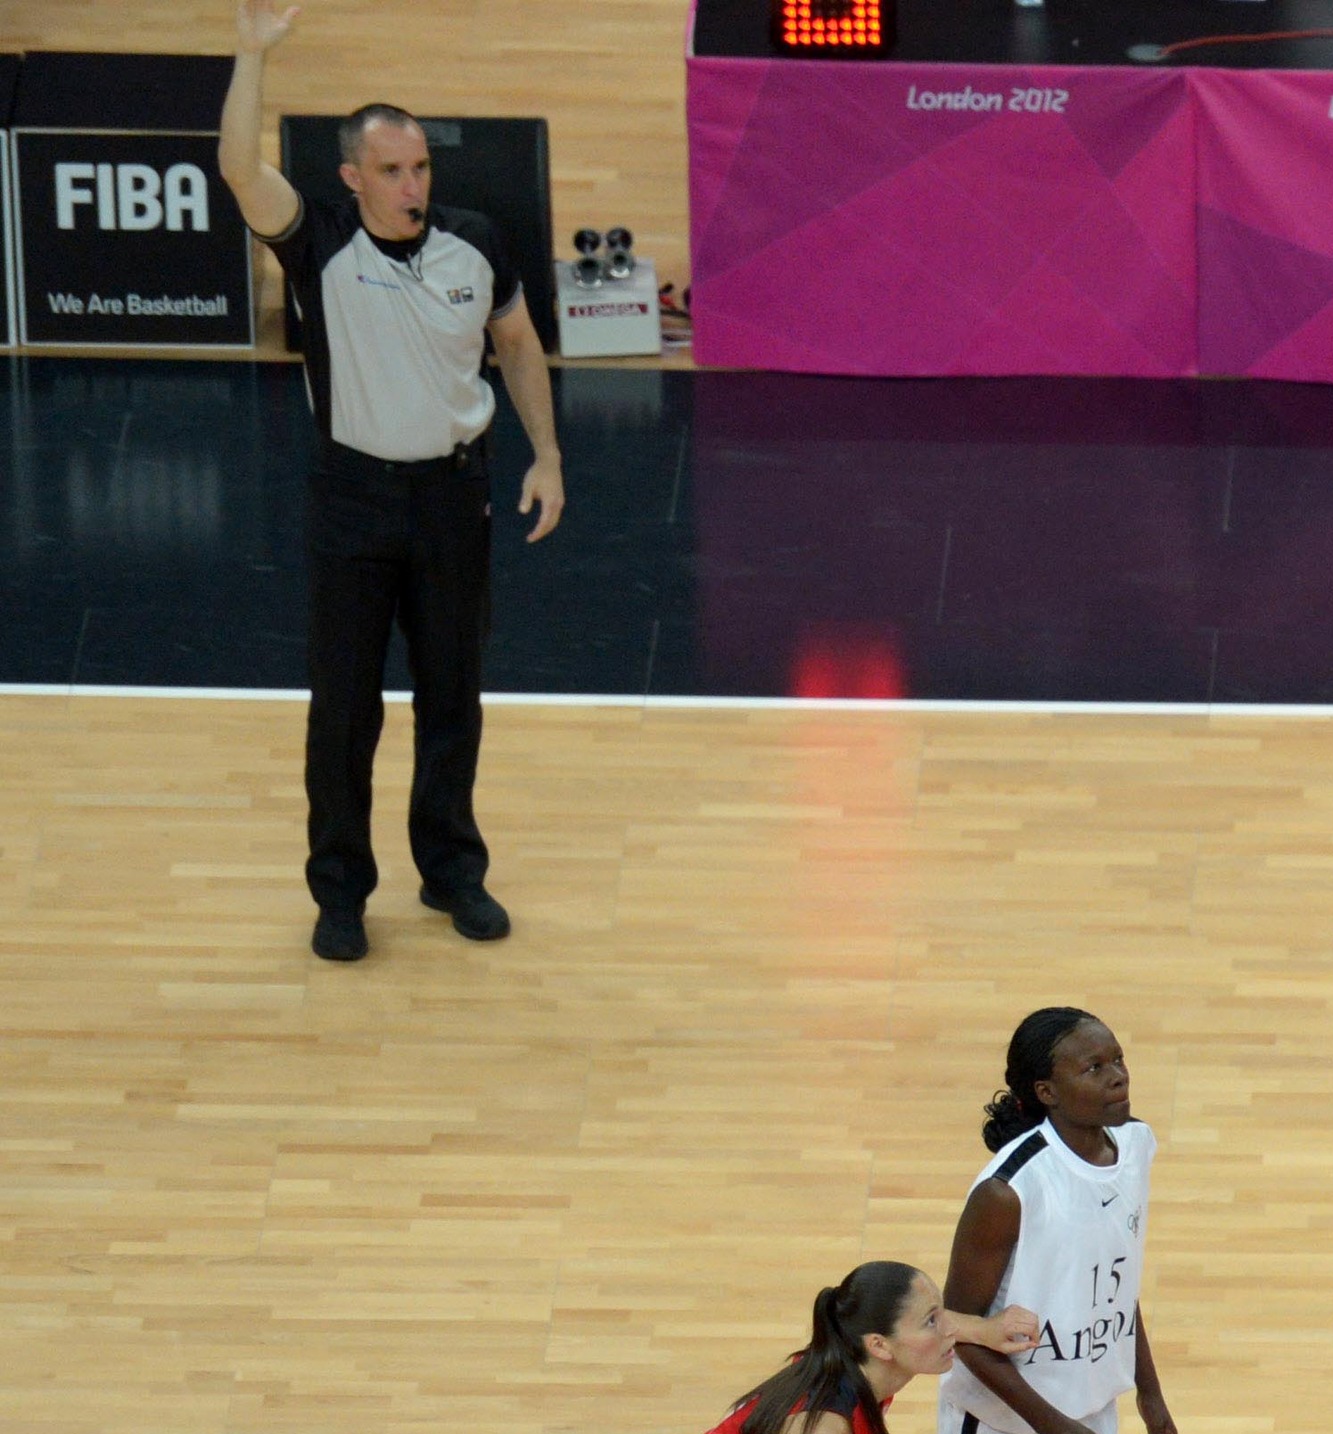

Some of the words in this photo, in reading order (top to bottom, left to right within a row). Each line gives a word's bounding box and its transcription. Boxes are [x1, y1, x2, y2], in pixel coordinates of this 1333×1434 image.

[907, 86, 1003, 111] London
[1009, 88, 1069, 112] 2012
[55, 162, 209, 232] FIBA
[48, 292, 83, 315] We
[88, 294, 124, 316] Are
[127, 294, 228, 318] Basketball
[1091, 1257, 1127, 1309] 15
